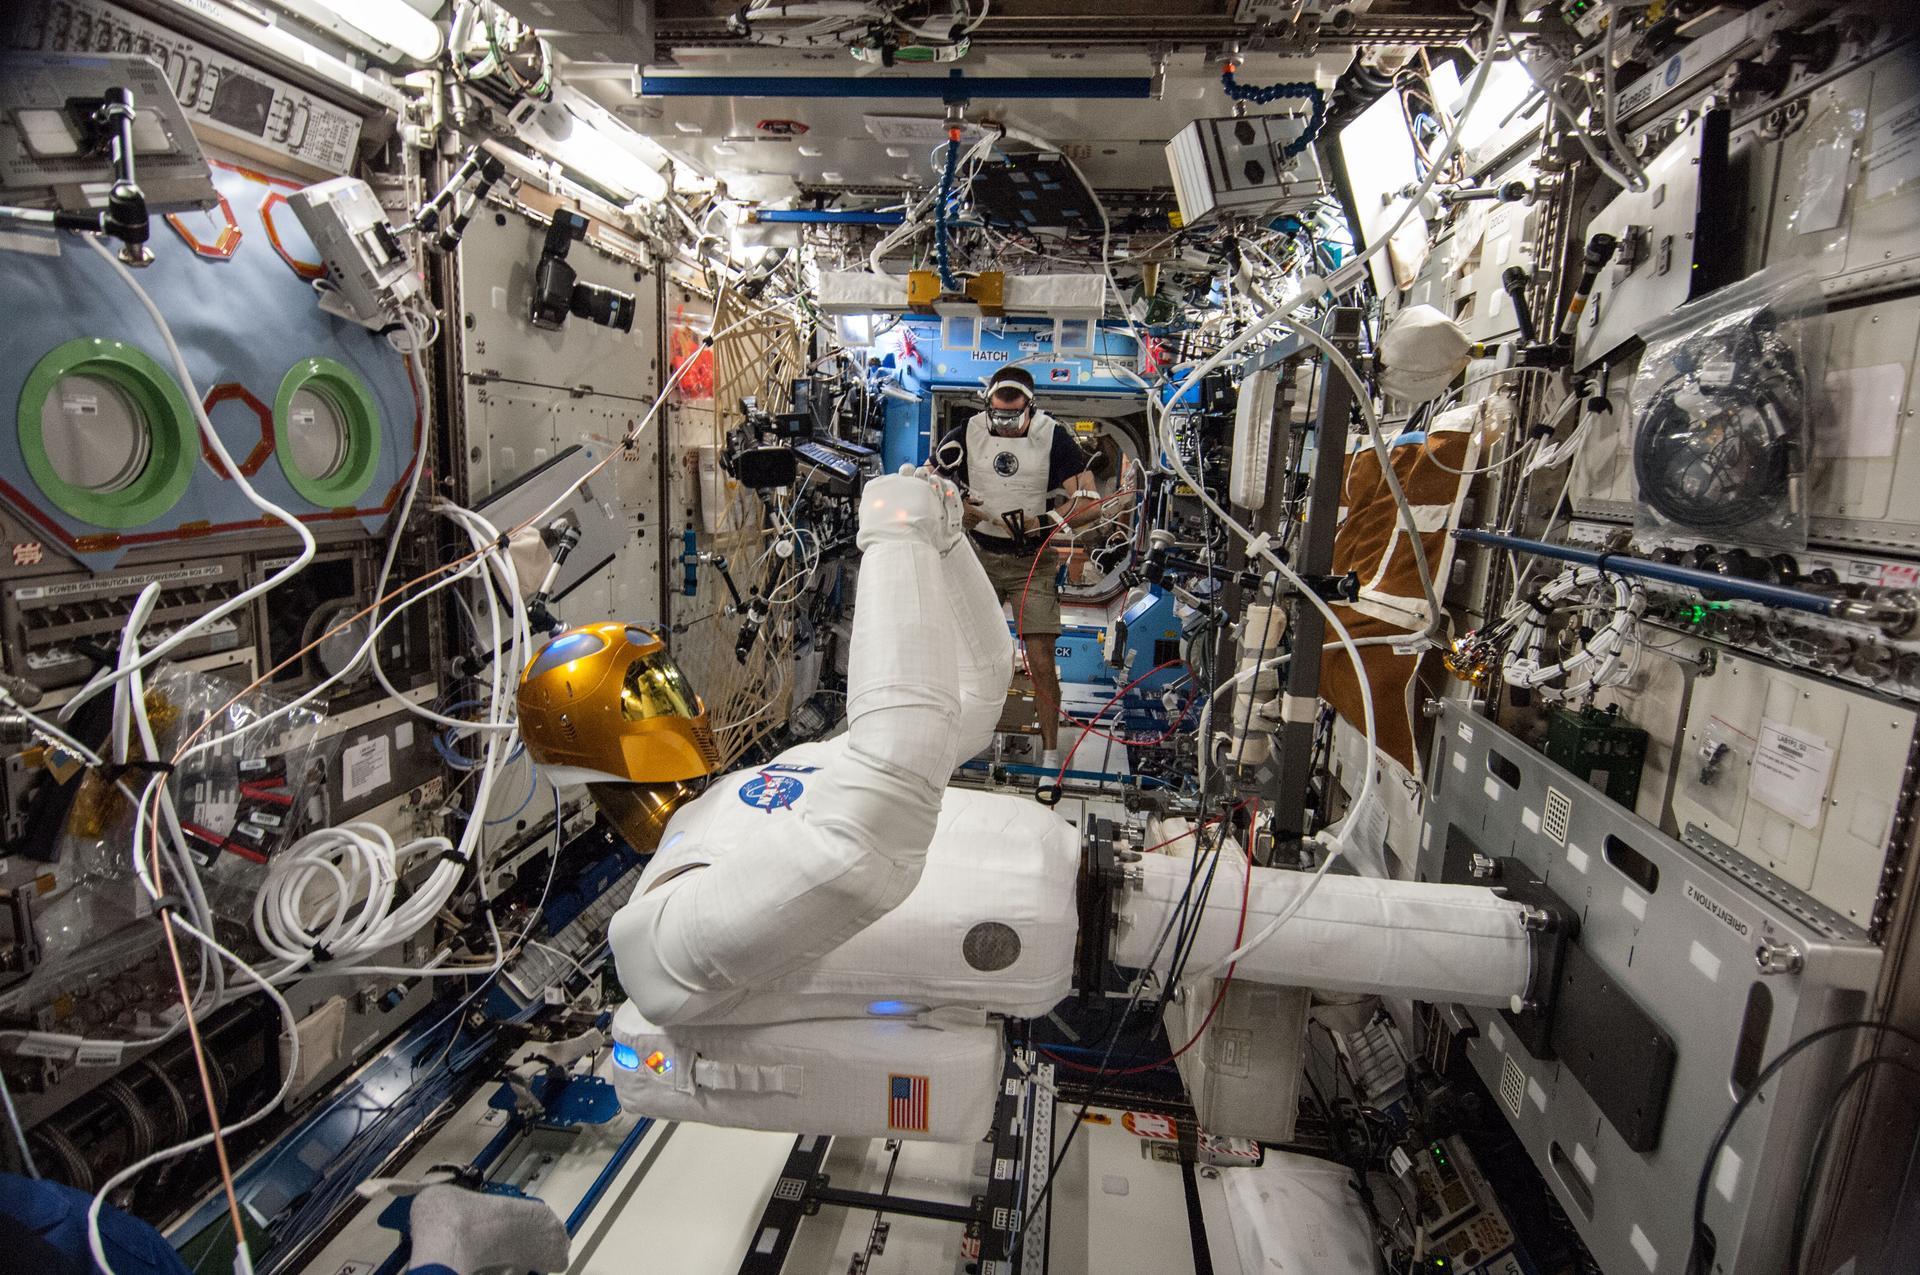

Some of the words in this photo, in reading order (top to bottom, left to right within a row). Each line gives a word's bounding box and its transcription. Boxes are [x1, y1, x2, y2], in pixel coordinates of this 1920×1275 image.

[972, 351, 1008, 361] HATCH
[48, 584, 78, 594] POWER
[79, 578, 129, 591] DISTRIBUTION
[130, 576, 145, 586] AND
[146, 571, 188, 581] CONVERSION
[1687, 886, 1694, 896] 2
[1693, 890, 1748, 936] ORIENTATION
